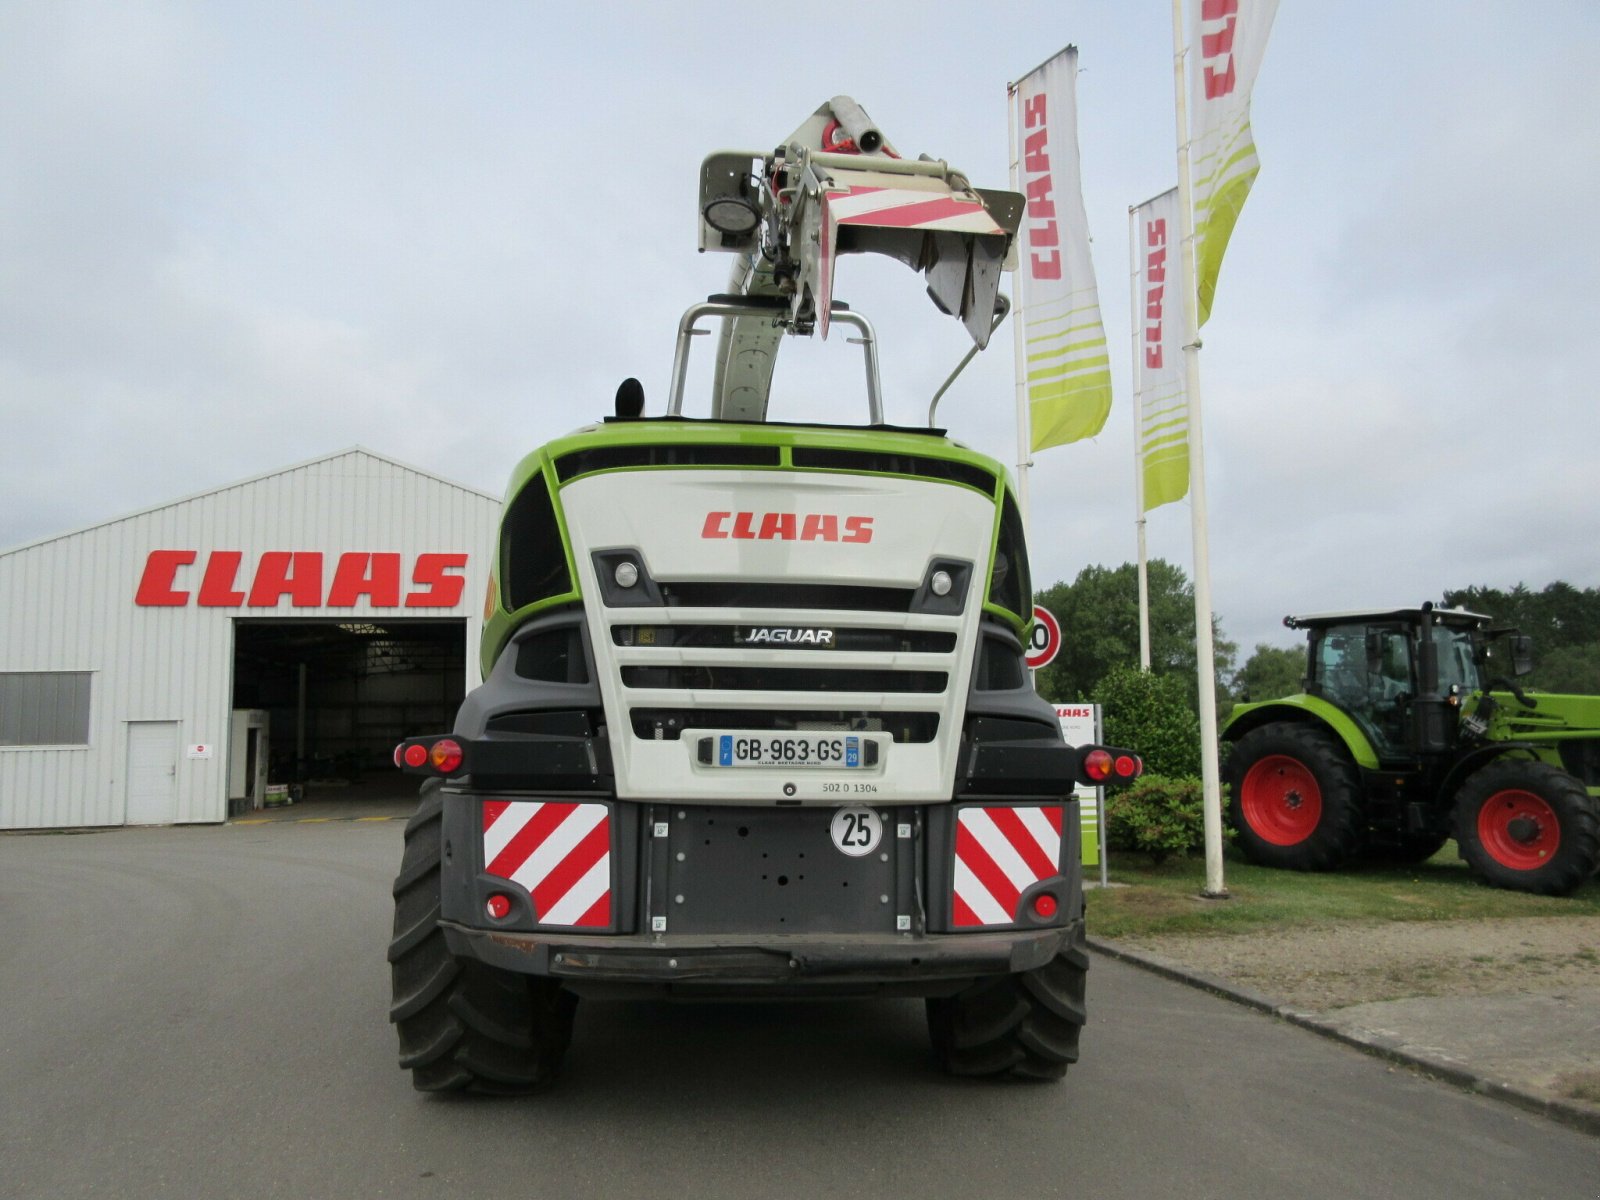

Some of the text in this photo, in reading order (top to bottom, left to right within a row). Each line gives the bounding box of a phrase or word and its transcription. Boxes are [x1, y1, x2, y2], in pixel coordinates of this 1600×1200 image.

[1024, 93, 1062, 281] CLAAS
[1146, 218, 1166, 369] CLAAS
[701, 511, 874, 544] CLAAS
[135, 550, 469, 607] CLAAS
[745, 628, 833, 644] JAGUAR
[1027, 623, 1050, 651] 0
[1056, 708, 1090, 718] LAAS
[736, 738, 843, 761] GB-963-GS
[847, 753, 857, 763] 29
[822, 783, 840, 792] 502
[854, 783, 878, 793] 1304
[842, 813, 871, 846] 25
